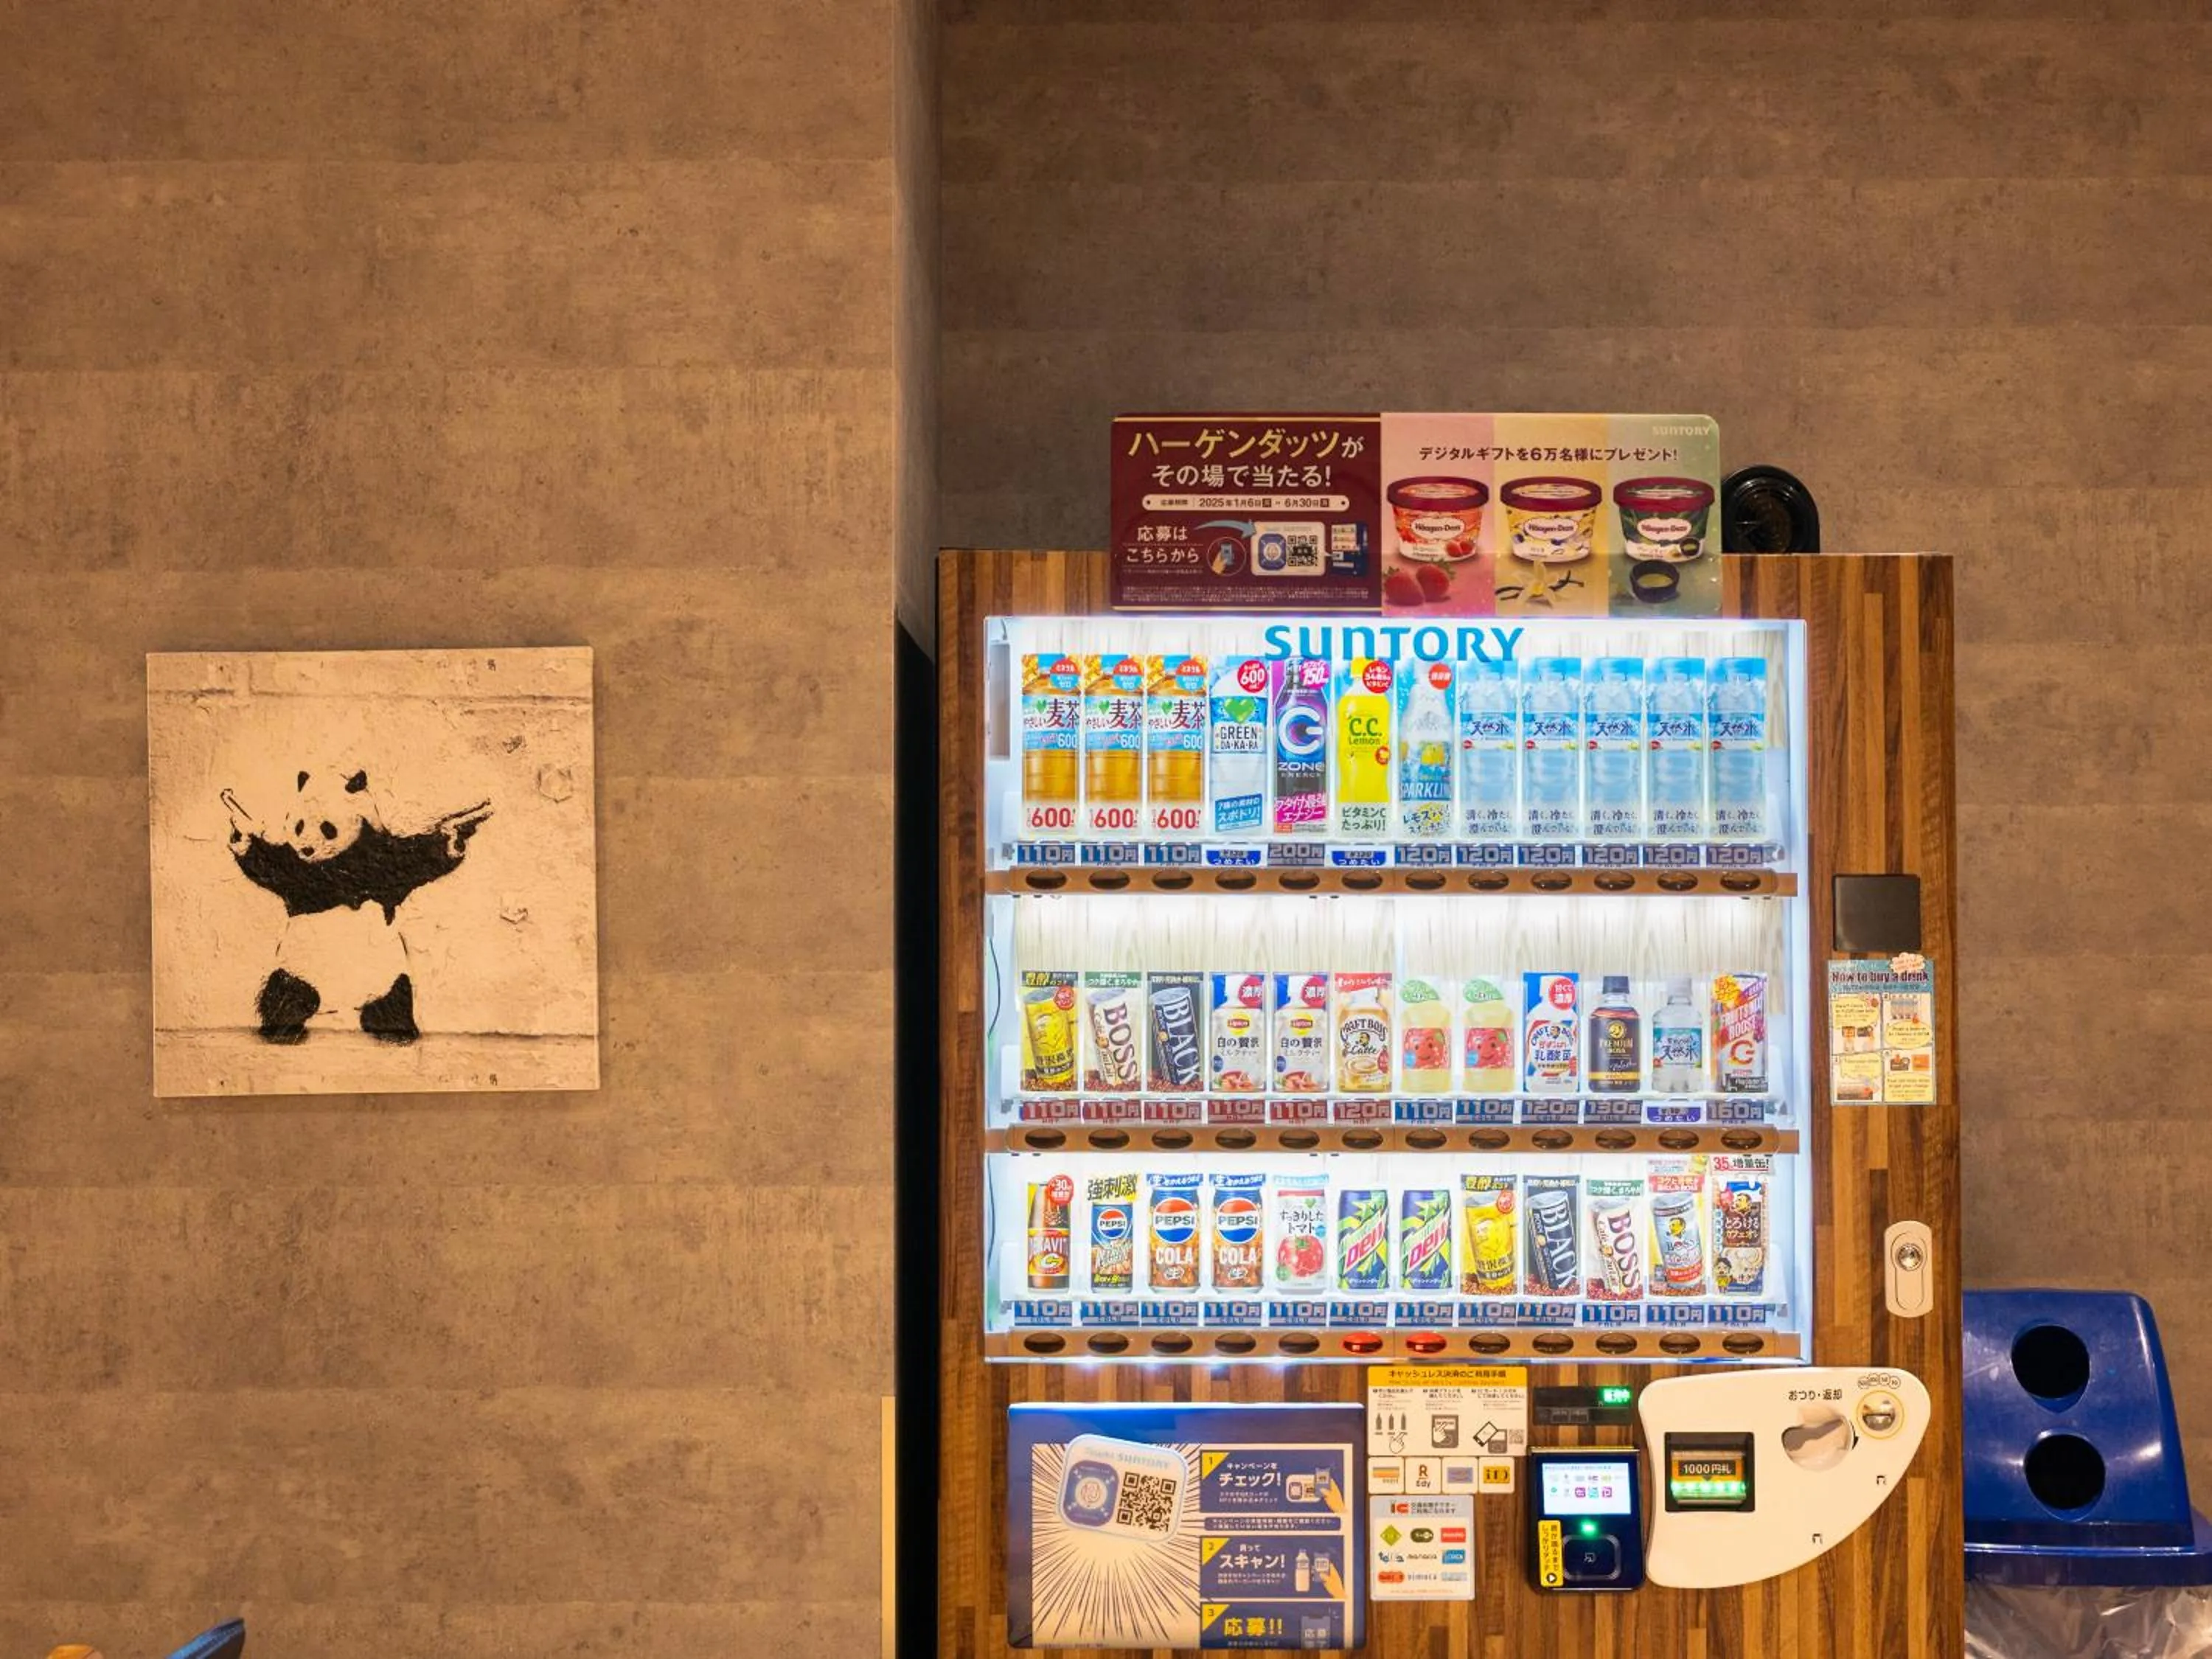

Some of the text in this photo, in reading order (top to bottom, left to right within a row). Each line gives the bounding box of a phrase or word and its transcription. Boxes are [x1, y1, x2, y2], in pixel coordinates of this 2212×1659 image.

[1127, 428, 1365, 459] ハーゲンダッツが
[1419, 447, 1678, 462] デジタルギフトを6万名様にプレゼント!
[1152, 465, 1332, 488] その場で当たる!
[1136, 526, 1189, 542] 応募は
[1127, 548, 1200, 564] こちらから
[1263, 625, 1525, 663] SUNTORY
[1240, 669, 1265, 685] 600
[1047, 698, 1080, 728] 麦茶
[1109, 698, 1142, 728] 麦茶
[1172, 698, 1206, 728] 麦茶
[1220, 726, 1258, 740] GREEN
[1470, 720, 1509, 736] 天然水
[1533, 721, 1572, 736] 天然水
[1595, 722, 1633, 736] 天然水
[1658, 722, 1697, 737] 天然水
[1719, 722, 1759, 737] 天然水
[1348, 737, 1381, 745] Lemon
[1341, 807, 1386, 818] ビタミンC
[1341, 818, 1386, 832] たっぷり!
[1023, 846, 1074, 862] 110円
[1085, 846, 1137, 862] 110円
[1148, 846, 1200, 862] 110円
[1268, 844, 1323, 858] 200円
[1400, 846, 1450, 862] 120円
[1461, 846, 1512, 862] 120円
[1524, 846, 1575, 862] 120円
[1587, 847, 1638, 863] 120円
[1646, 847, 1700, 863] 120円
[1710, 847, 1762, 863] 120円
[1103, 1002, 1138, 1081] BOSS
[1162, 996, 1201, 1085] BLACK
[1660, 1044, 1699, 1061] 天然水
[1028, 1102, 1079, 1118] 110円
[1088, 1102, 1139, 1118] 110円
[1147, 1102, 1200, 1119] 110円
[1211, 1101, 1264, 1115] 110円
[1273, 1102, 1326, 1119] 110円
[1338, 1102, 1391, 1119] 120円
[1401, 1102, 1451, 1119] 110円
[1461, 1100, 1512, 1115] 110円
[1526, 1100, 1577, 1115] 120円
[1589, 1100, 1641, 1115] 130円
[1708, 1102, 1761, 1119] 160円
[1155, 1215, 1195, 1226] PEPSI
[1217, 1215, 1259, 1226] PEPSI
[1280, 1210, 1324, 1222] すっきりした
[1288, 1222, 1314, 1234] トマト
[1540, 1200, 1578, 1287] BLACK
[1607, 1210, 1641, 1289] BOSS
[1155, 1246, 1193, 1265] COLA
[1219, 1246, 1257, 1265] COLA
[1019, 1300, 1070, 1317] 110円
[1086, 1301, 1138, 1317] 110円
[1146, 1301, 1197, 1317] 110円
[1210, 1301, 1259, 1317] 110円
[1274, 1301, 1325, 1317] 110円
[1336, 1301, 1388, 1317] 110円
[1401, 1302, 1451, 1318] 110円
[1464, 1302, 1515, 1318] 110円
[1523, 1302, 1574, 1318] 110円
[1587, 1305, 1638, 1321] 110円
[1651, 1305, 1703, 1321] 110円
[1711, 1305, 1764, 1321] 110円
[1788, 1390, 1843, 1401] おつり・返却
[1683, 1463, 1731, 1475] 1000円札
[1219, 1472, 1281, 1487] チェック!
[1416, 1480, 1431, 1489] Edy
[1219, 1553, 1285, 1569] スキャン!
[1223, 1617, 1283, 1637] 応募!!
